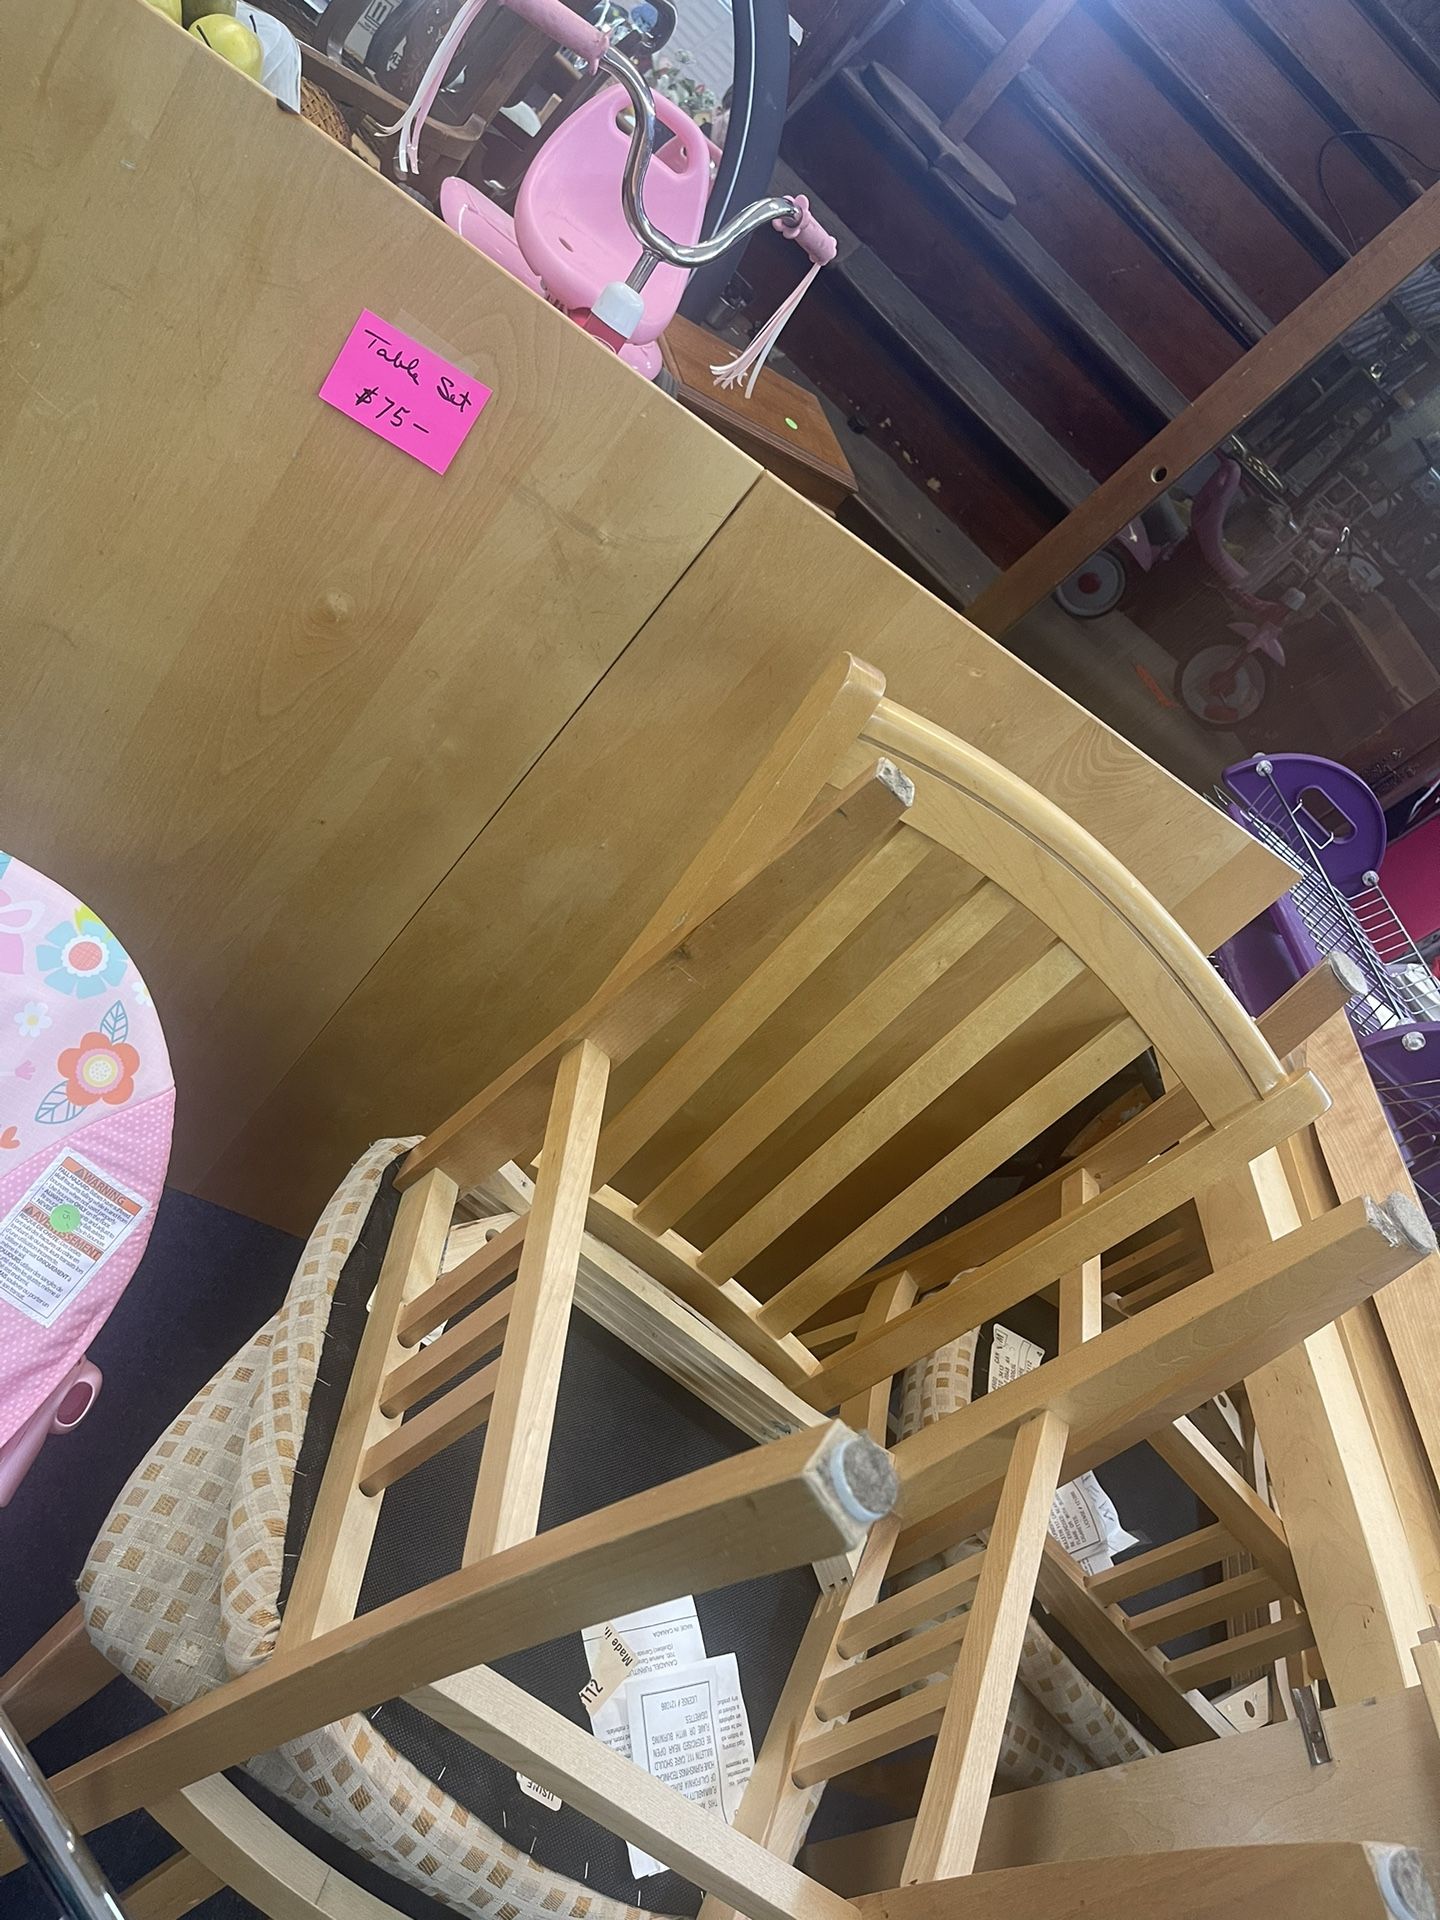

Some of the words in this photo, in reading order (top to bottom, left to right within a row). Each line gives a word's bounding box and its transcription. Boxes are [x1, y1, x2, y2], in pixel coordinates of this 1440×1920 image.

[364, 329, 420, 386] Table
[436, 376, 472, 413] Set
[83, 1172, 125, 1205] WARNING
[611, 1638, 633, 1667] Made
[579, 1679, 604, 1704] 112
